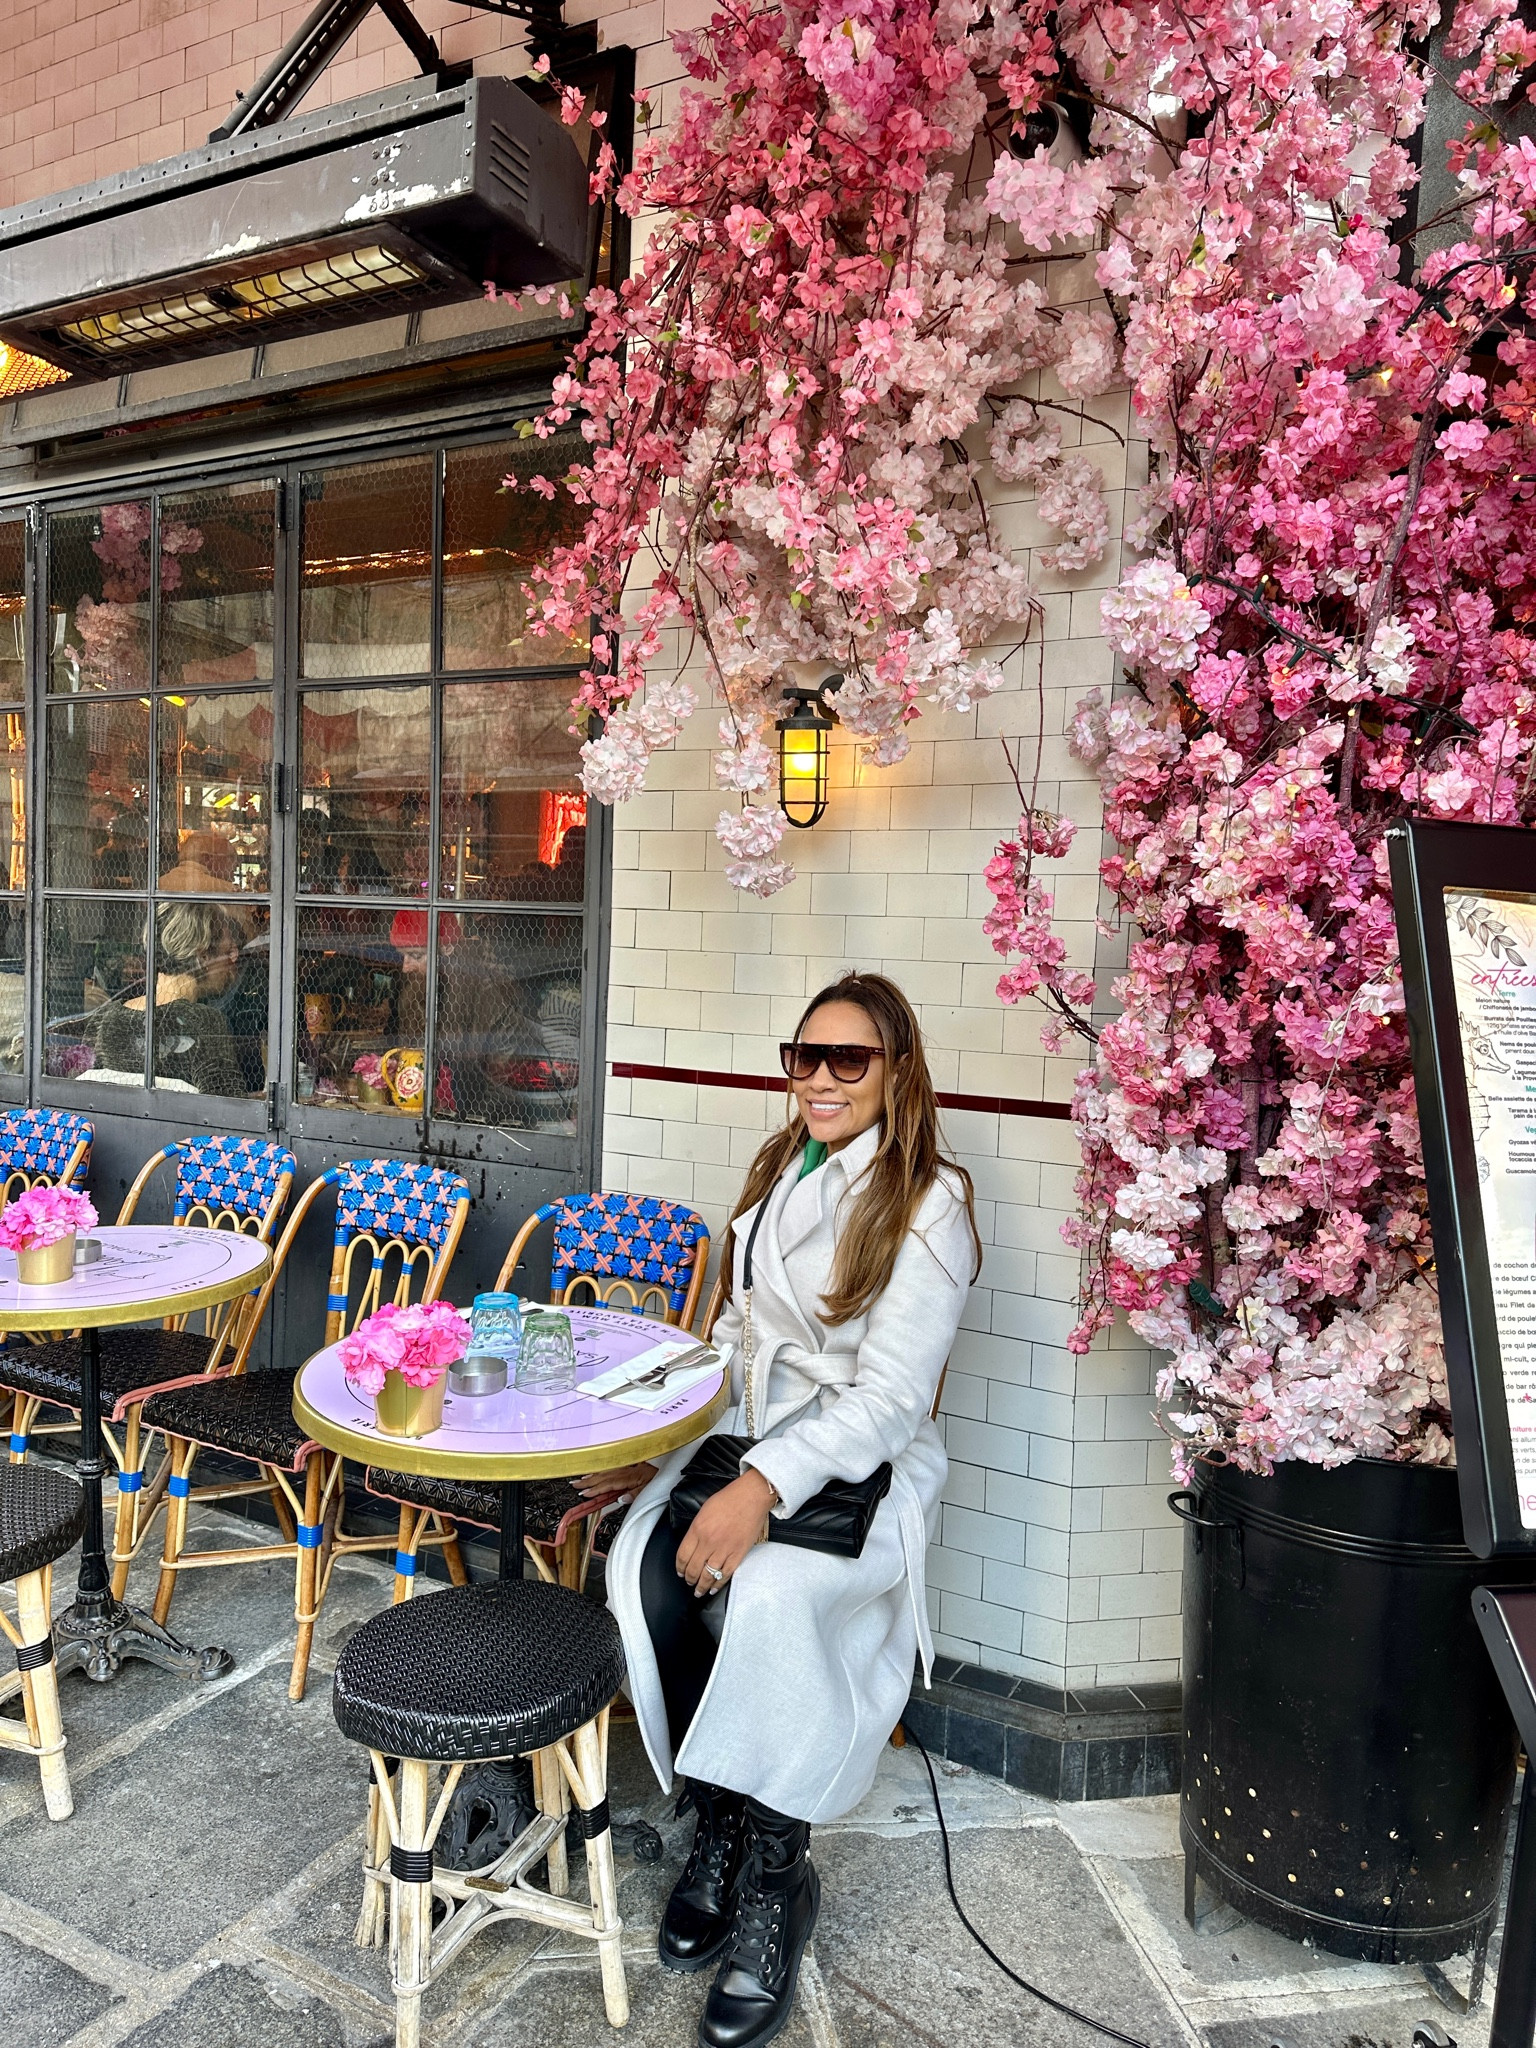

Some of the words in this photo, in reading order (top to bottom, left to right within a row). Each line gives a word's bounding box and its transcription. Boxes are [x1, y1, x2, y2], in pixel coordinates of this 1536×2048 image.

[1503, 1288, 1531, 1296] légumes
[1514, 1342, 1525, 1350] qui
[660, 1398, 689, 1414] PARIS
